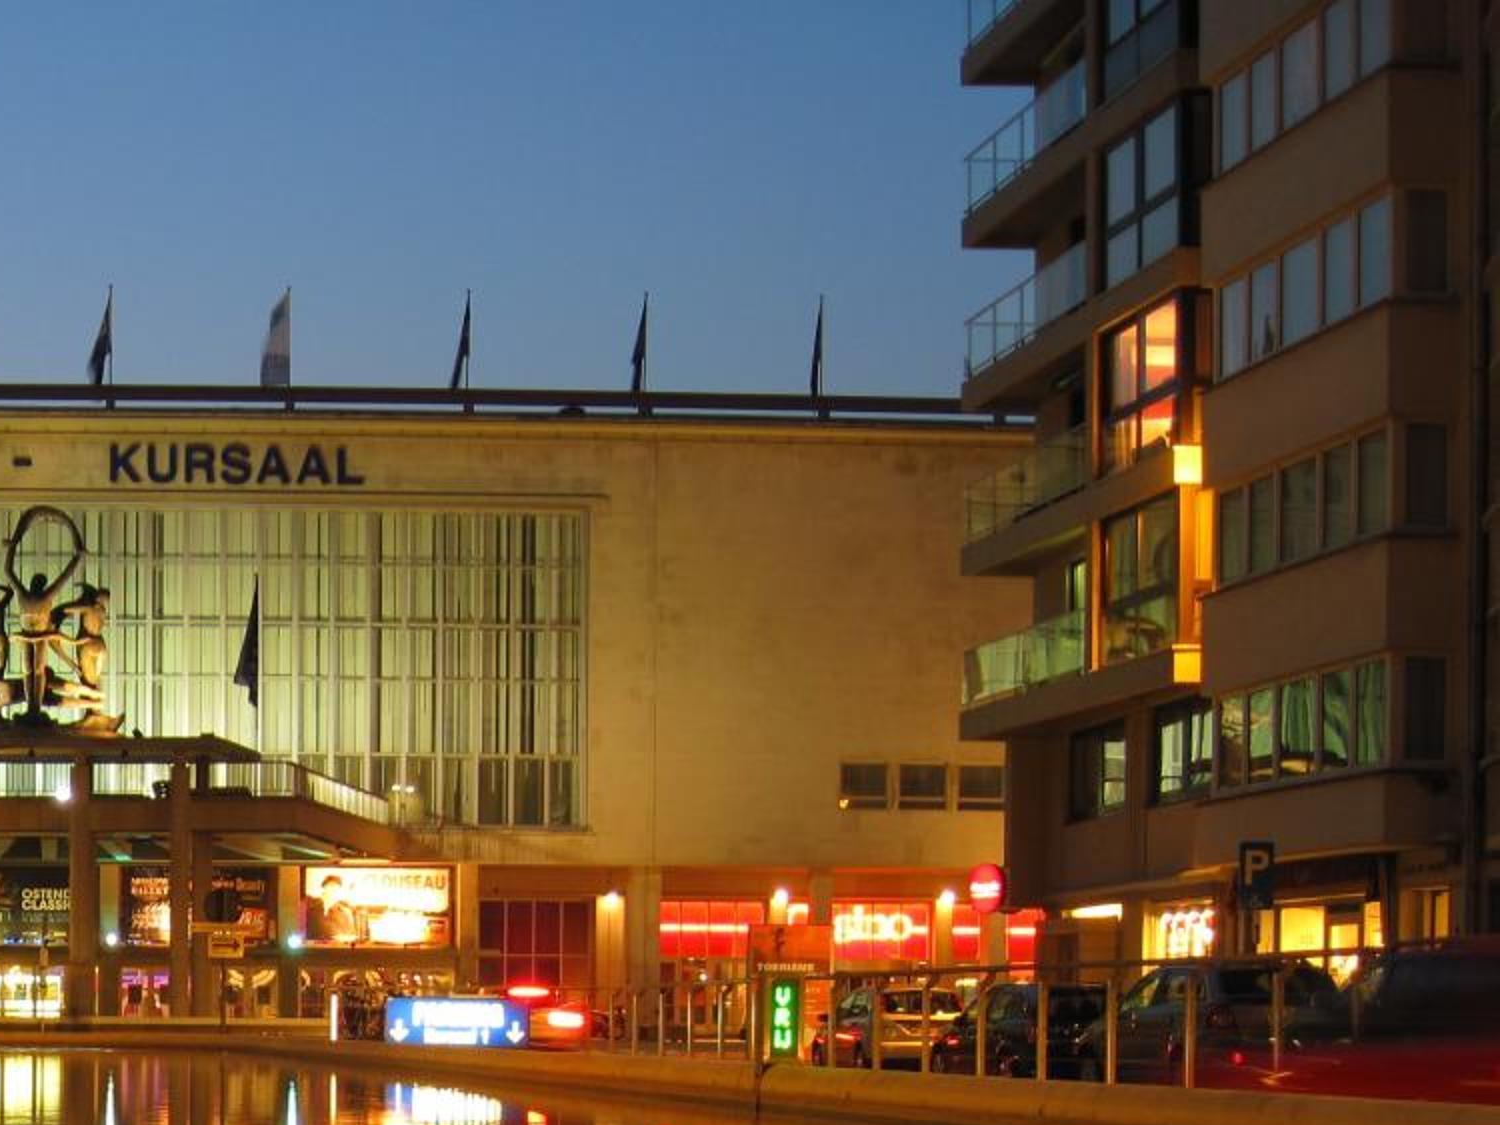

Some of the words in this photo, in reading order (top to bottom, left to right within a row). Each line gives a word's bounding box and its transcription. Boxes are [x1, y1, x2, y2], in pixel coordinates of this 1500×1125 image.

[109, 442, 366, 485] KURSAAL
[1245, 850, 1269, 886] P
[21, 900, 69, 911] CLASSI
